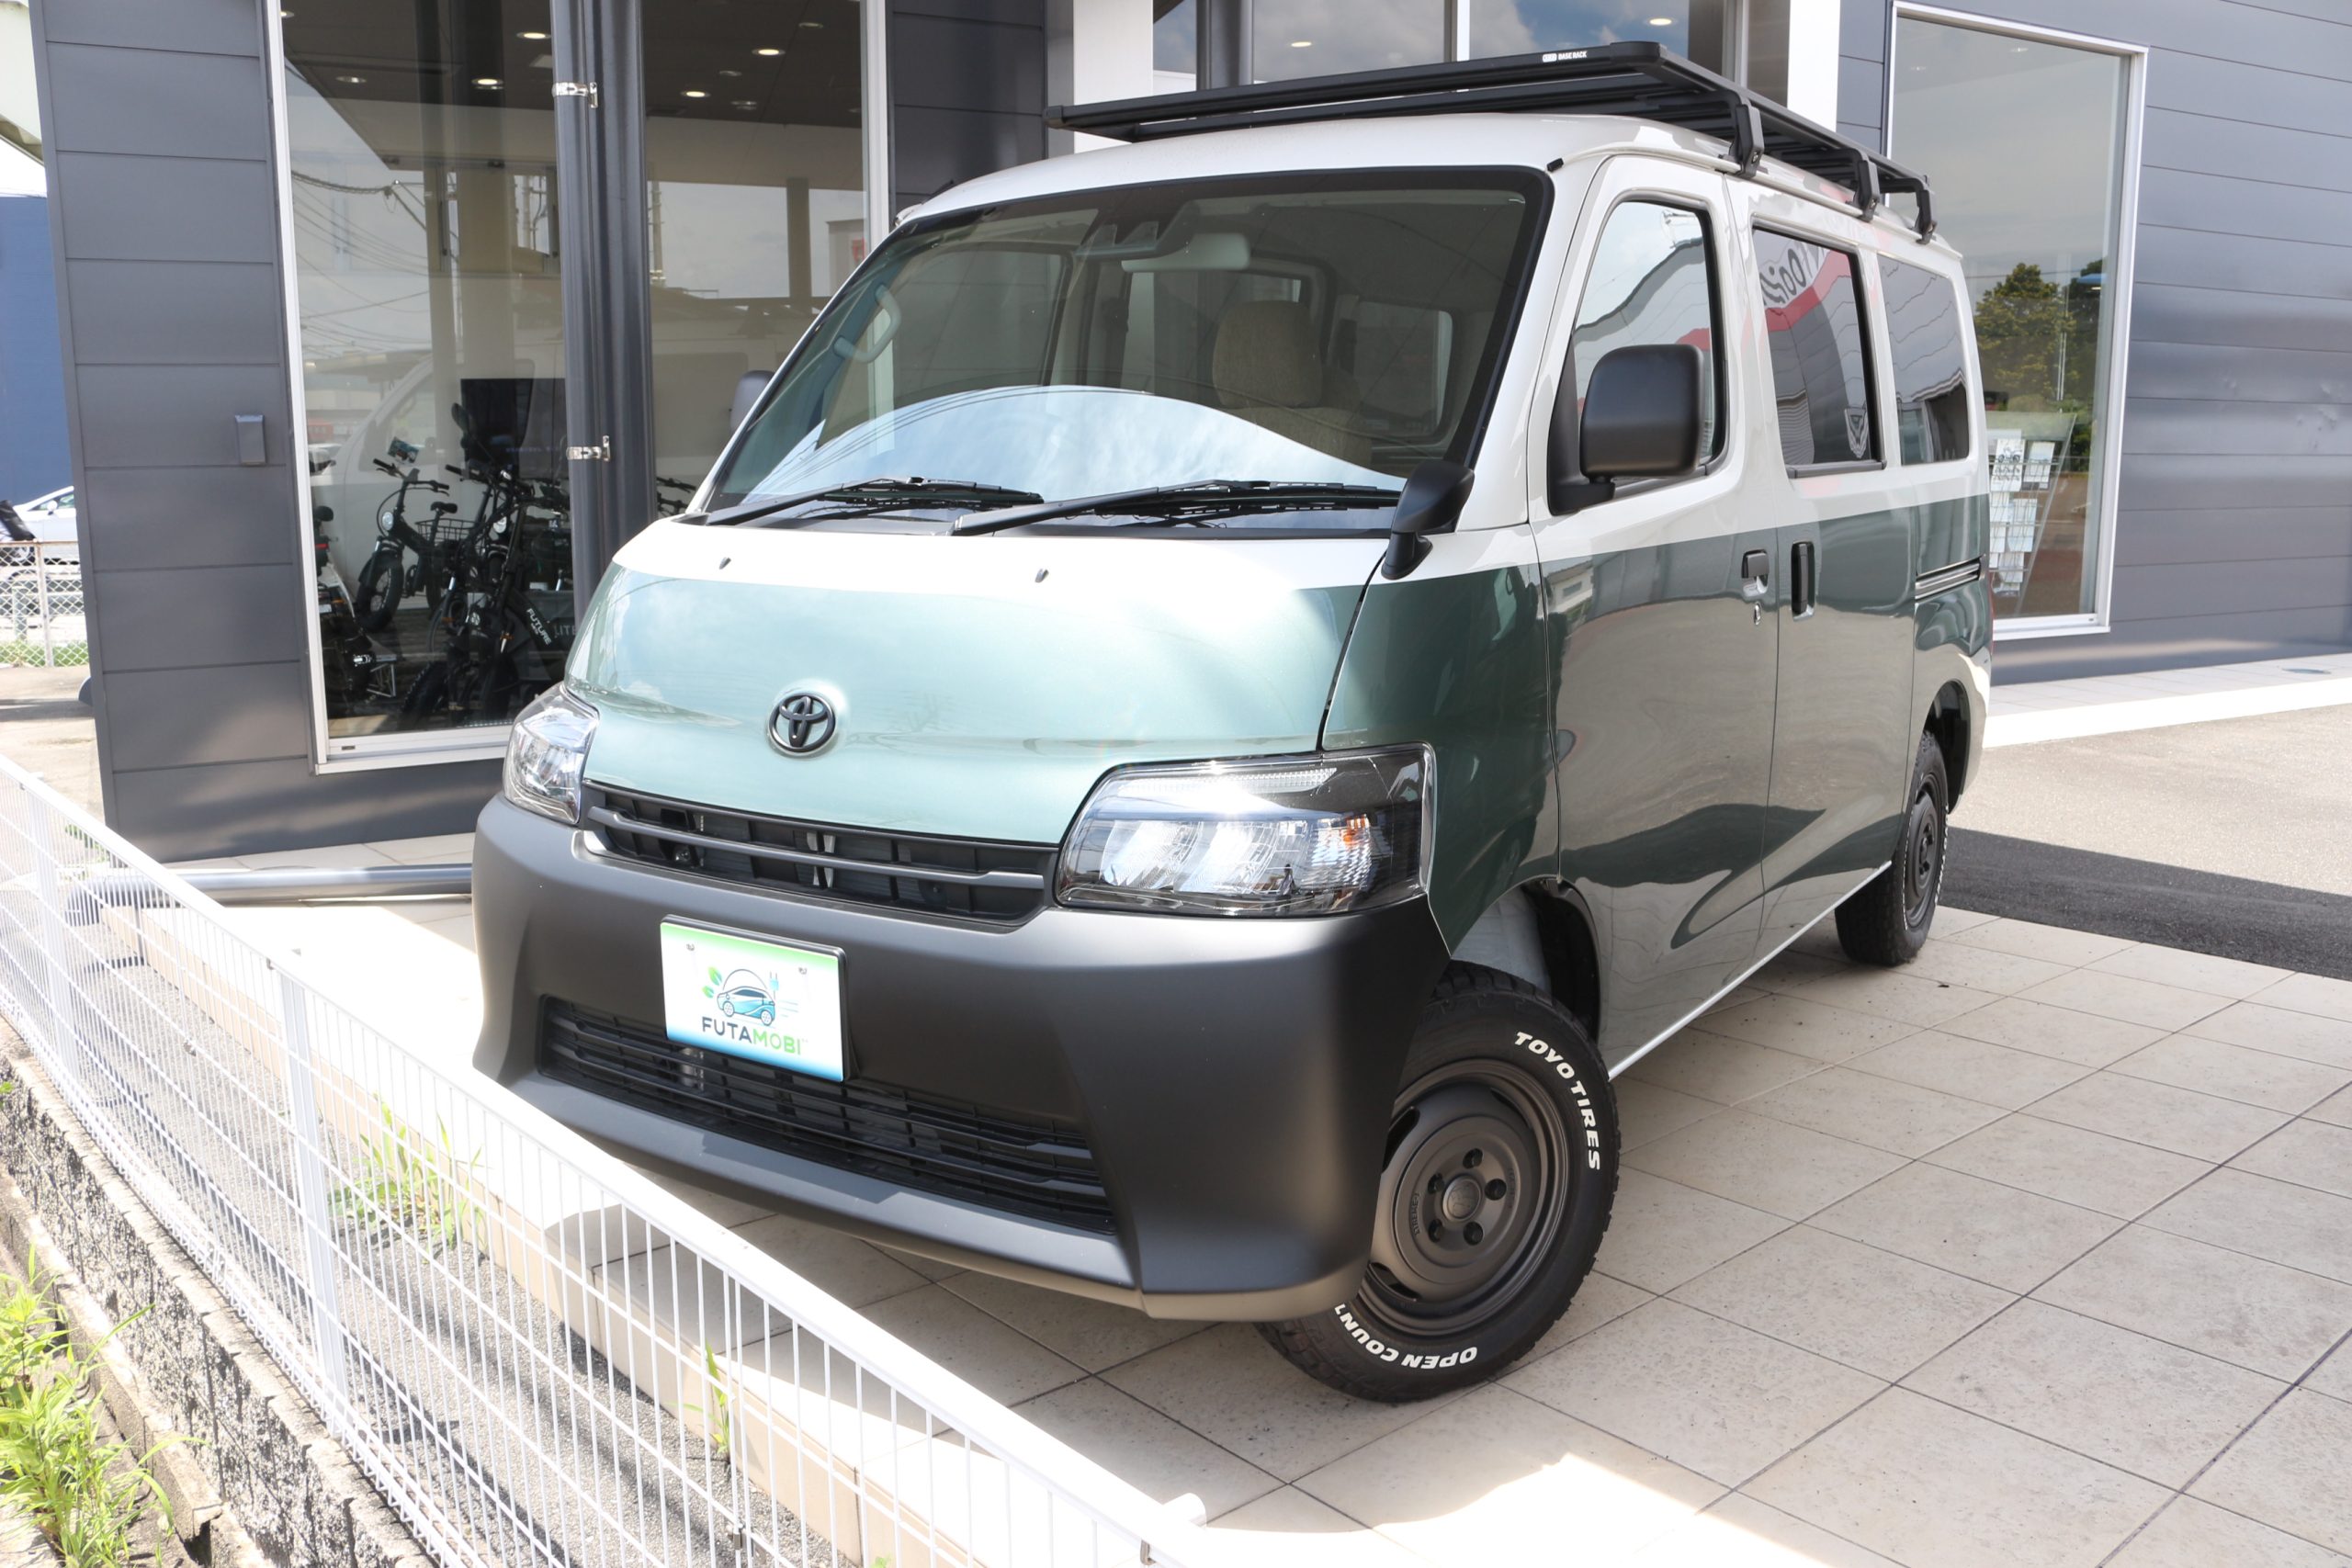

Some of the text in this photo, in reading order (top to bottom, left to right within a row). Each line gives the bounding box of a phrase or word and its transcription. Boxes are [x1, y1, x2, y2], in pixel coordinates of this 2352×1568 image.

[1572, 50, 1588, 59] RACK
[526, 607, 552, 645] FUTURE
[701, 1016, 801, 1055] FUTAMOBI
[1514, 1031, 1600, 1170] TOYO TIRES
[1401, 1347, 1478, 1370] OPEN
